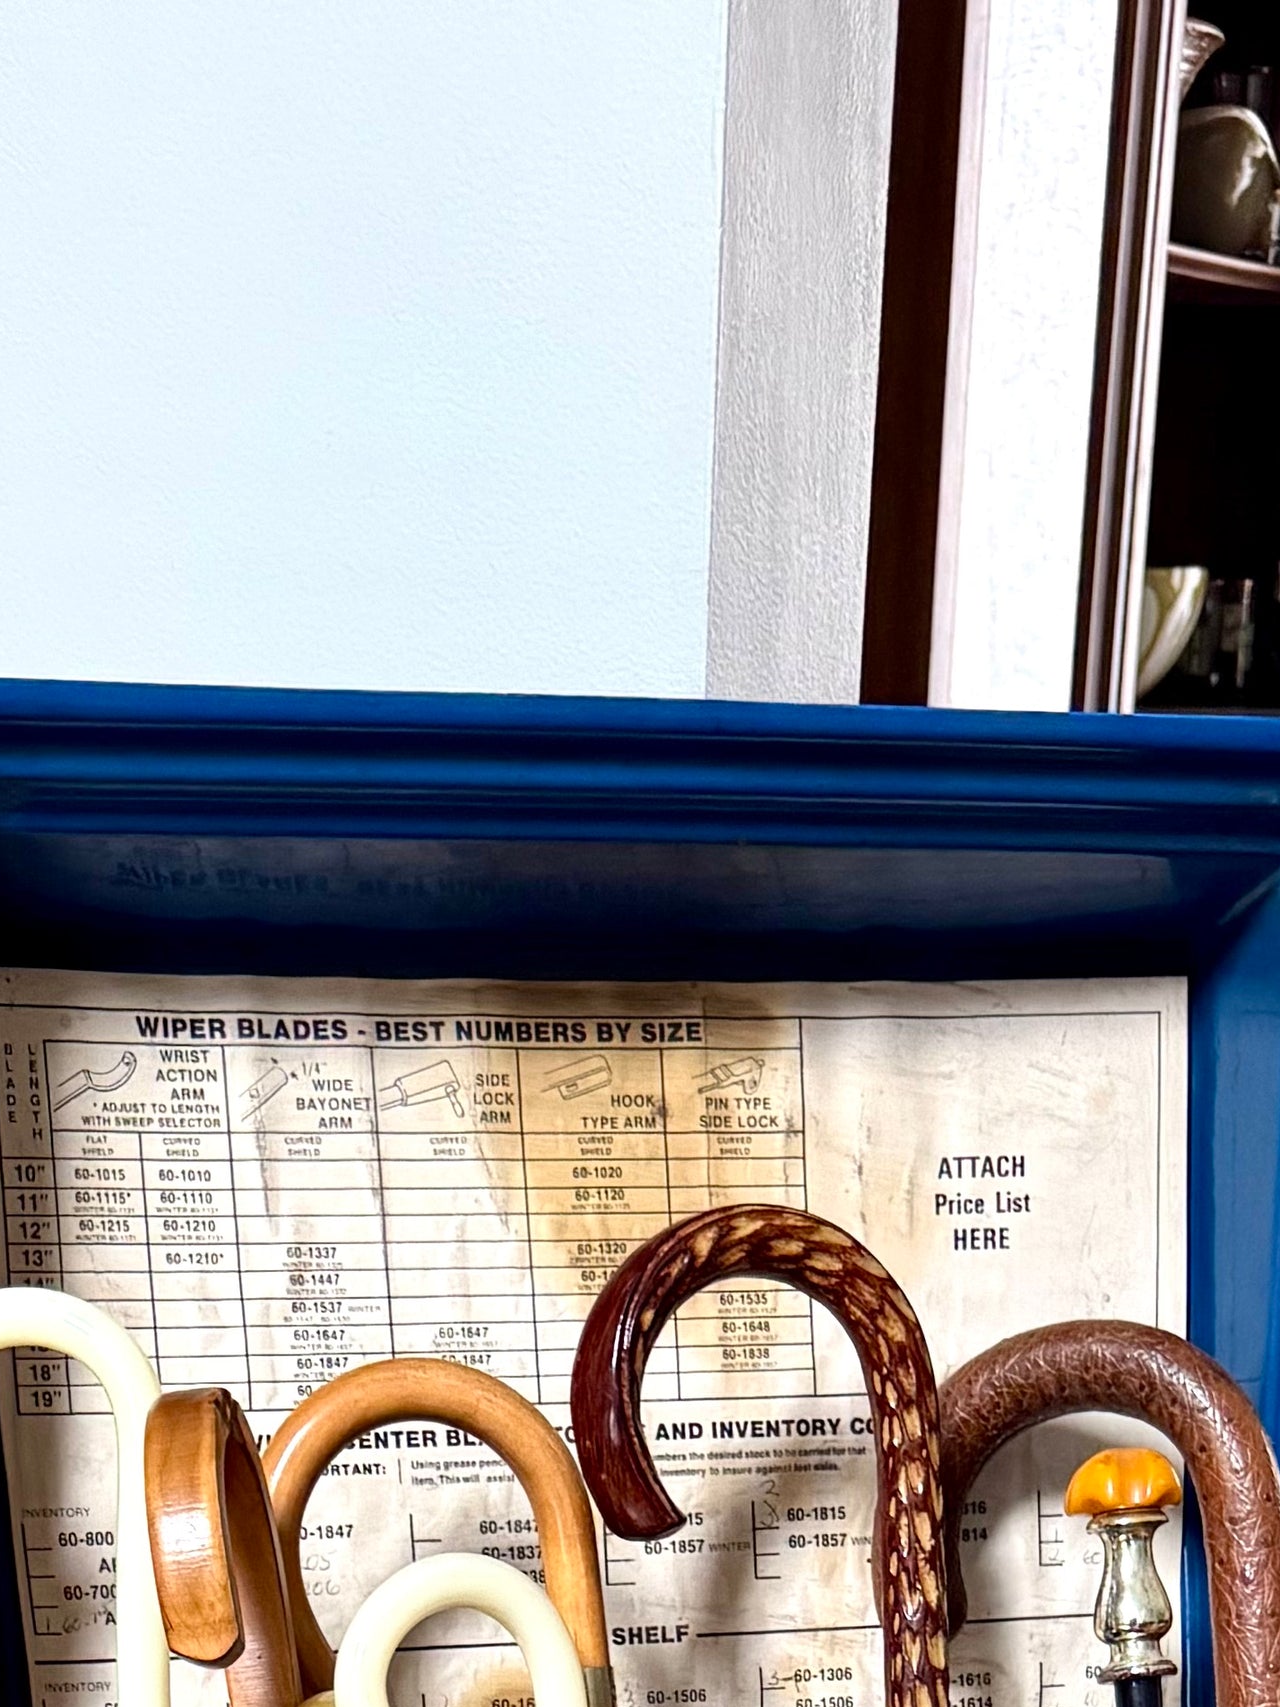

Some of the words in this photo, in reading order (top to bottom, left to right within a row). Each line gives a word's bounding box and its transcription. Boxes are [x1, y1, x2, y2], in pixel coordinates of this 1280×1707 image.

[136, 1016, 226, 1039] WIPER
[237, 1018, 348, 1041] BLADES
[375, 1020, 445, 1042] BEST
[456, 1021, 586, 1043] NUMBERS
[596, 1022, 632, 1042] BY
[641, 1022, 703, 1042] SIZE
[160, 1050, 209, 1063] WRIST
[156, 1069, 218, 1083] ACTION
[476, 1074, 510, 1088] SIDE
[312, 1079, 354, 1092] WIDE
[171, 1088, 206, 1101] ARM
[474, 1092, 515, 1106] LOCK
[102, 1102, 147, 1114] ADJUST
[152, 1103, 167, 1114] TO
[172, 1103, 220, 1114] LENGTH
[296, 1098, 371, 1112] BAYONET
[610, 1095, 655, 1108] HOOK
[705, 1097, 729, 1110] PIN
[734, 1098, 771, 1110] TYPE
[81, 1116, 112, 1127] WITH
[114, 1116, 154, 1128] SWEEP
[158, 1117, 221, 1128] SELECTOR
[318, 1117, 353, 1129] ARM
[480, 1111, 512, 1124] ARM
[581, 1117, 618, 1129] TYPE
[624, 1117, 657, 1129] ARM
[699, 1115, 732, 1128] SIDE
[738, 1115, 779, 1128] LOCK
[14, 1164, 46, 1182] 10"
[74, 1168, 126, 1181] 60-1015
[572, 1167, 623, 1179] 60-1020
[938, 1156, 1025, 1180] ATTACH
[158, 1169, 212, 1182] 60-1010
[18, 1193, 49, 1212] 11"
[160, 1192, 213, 1205] 60-1110
[575, 1190, 625, 1202] 60-1120
[935, 1192, 985, 1216] Price
[996, 1191, 1031, 1213] List
[19, 1222, 51, 1241] 12"
[79, 1220, 130, 1233] 60-1215
[163, 1220, 215, 1233] 60-1210
[954, 1227, 1010, 1251] HERE
[286, 1247, 337, 1259] 60-1337
[577, 1243, 627, 1255] 60-1320
[22, 1250, 53, 1267] 13"
[289, 1274, 340, 1286] 60-1447
[720, 1294, 768, 1306] 60-1535
[291, 1302, 342, 1314] 60-1537
[438, 1328, 489, 1339] 60-1647
[722, 1322, 770, 1332] 60-1648
[294, 1330, 345, 1341] 60-1647
[723, 1348, 770, 1360] 60-1838
[297, 1358, 348, 1369] 60-1847
[29, 1364, 61, 1381] 18"
[31, 1391, 62, 1408] 19"
[656, 1423, 703, 1441] AND
[712, 1418, 840, 1439] INVENTORY
[411, 1460, 441, 1471] Using
[443, 1460, 477, 1471] grease
[689, 1452, 705, 1461] the
[707, 1450, 743, 1460] desired
[745, 1448, 770, 1459] stock
[848, 1446, 866, 1456] that
[439, 1474, 461, 1485] This
[462, 1474, 480, 1483] will
[710, 1467, 720, 1476] to
[22, 1508, 91, 1518] INVENTORY
[788, 1506, 846, 1522] 60-1815
[300, 1524, 353, 1540] 0-1847
[788, 1533, 848, 1548] 60-1857
[851, 1536, 871, 1546] WIN
[644, 1540, 705, 1555] 60-1857
[612, 1624, 689, 1645] SHELF
[794, 1667, 853, 1683] 60-1306
[952, 1672, 992, 1687] -1616
[45, 1682, 111, 1693] INVENTORY
[647, 1689, 707, 1704] 60-1506
